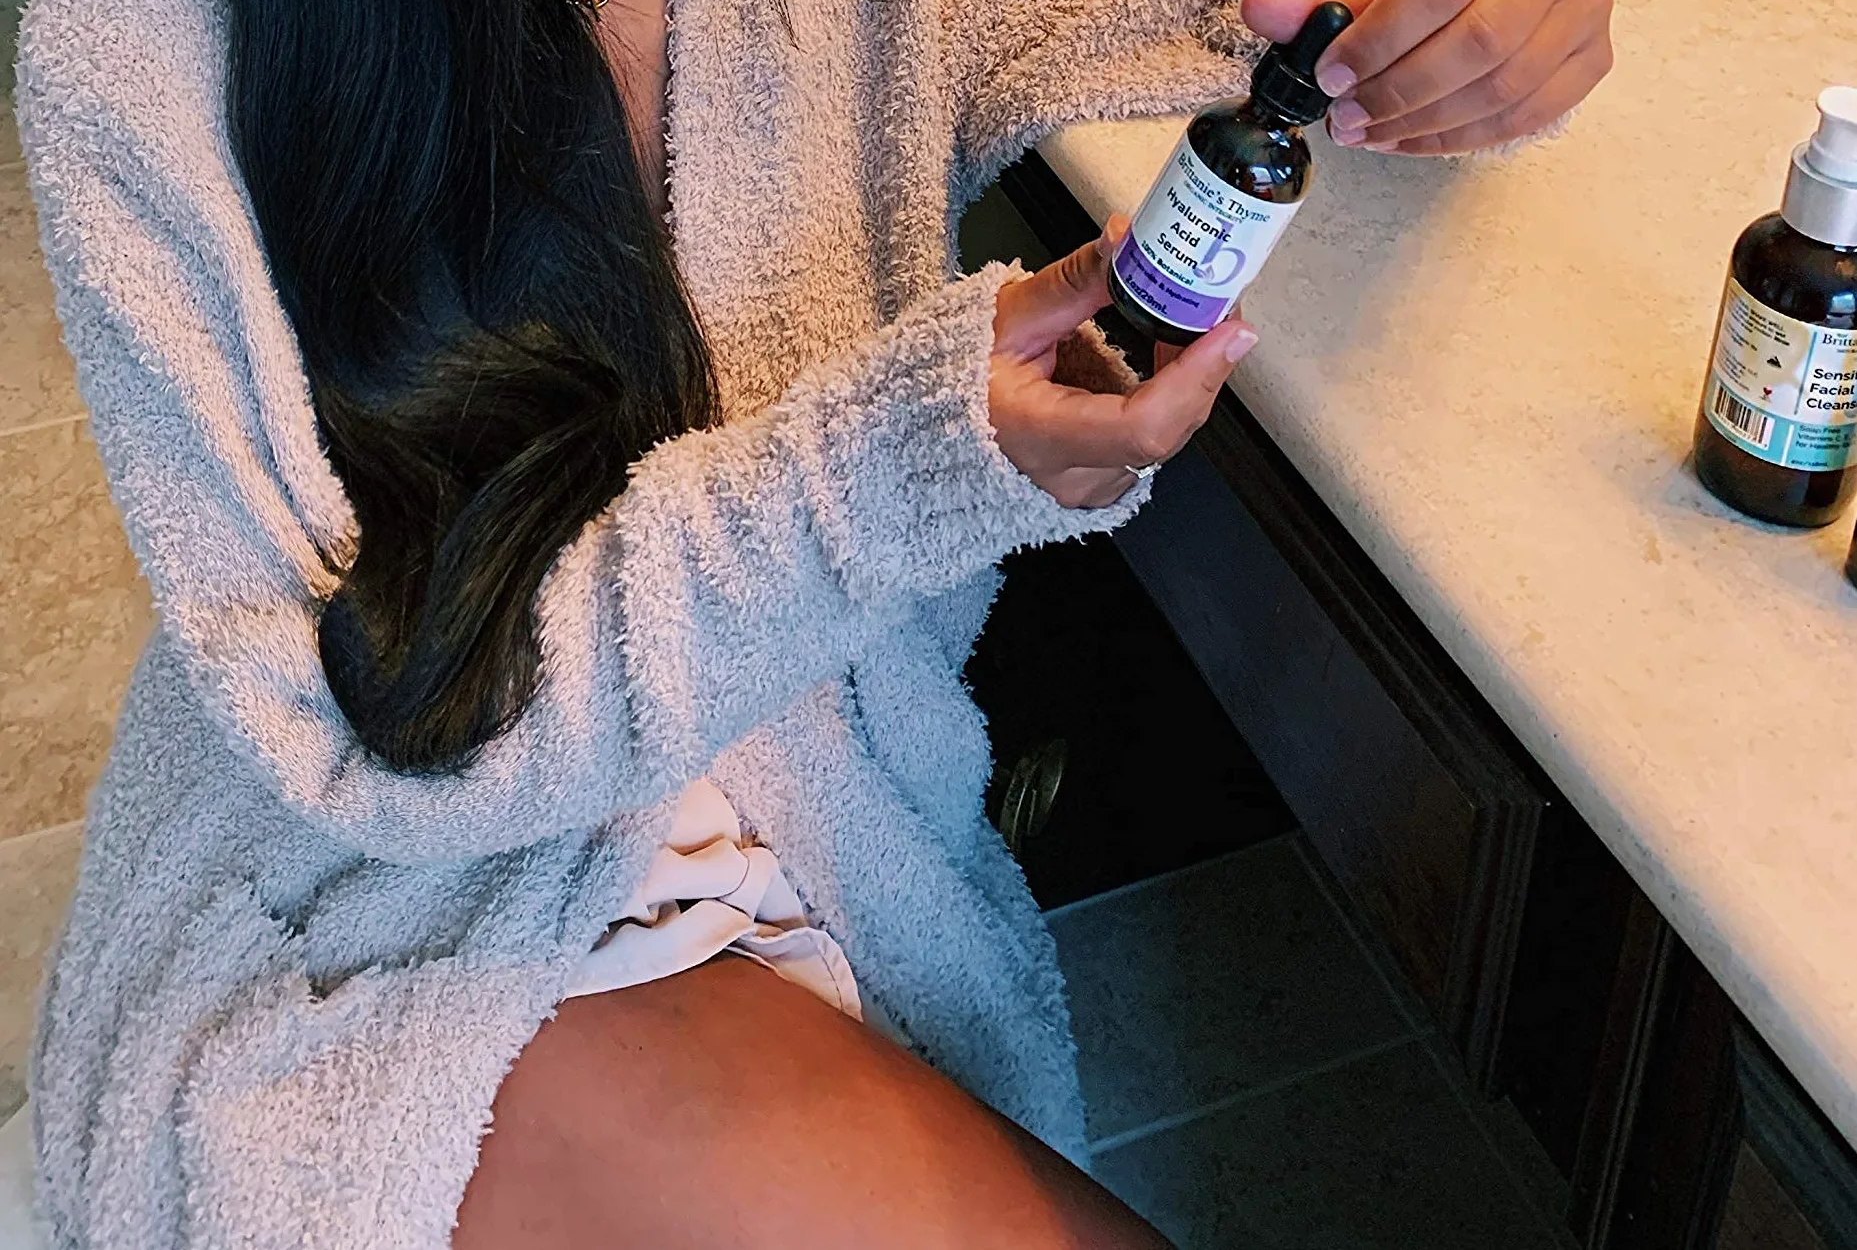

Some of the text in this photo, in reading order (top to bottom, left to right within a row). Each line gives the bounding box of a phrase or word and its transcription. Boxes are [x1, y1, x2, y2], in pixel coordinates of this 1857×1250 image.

[1167, 186, 1232, 242] Hyaluronic
[1228, 198, 1270, 222] Thyme
[1170, 221, 1201, 248] Acid
[1157, 232, 1199, 270] Serum
[1157, 257, 1194, 286] Botanical
[1809, 383, 1855, 395] Facial
[1806, 398, 1857, 410] Cleans
